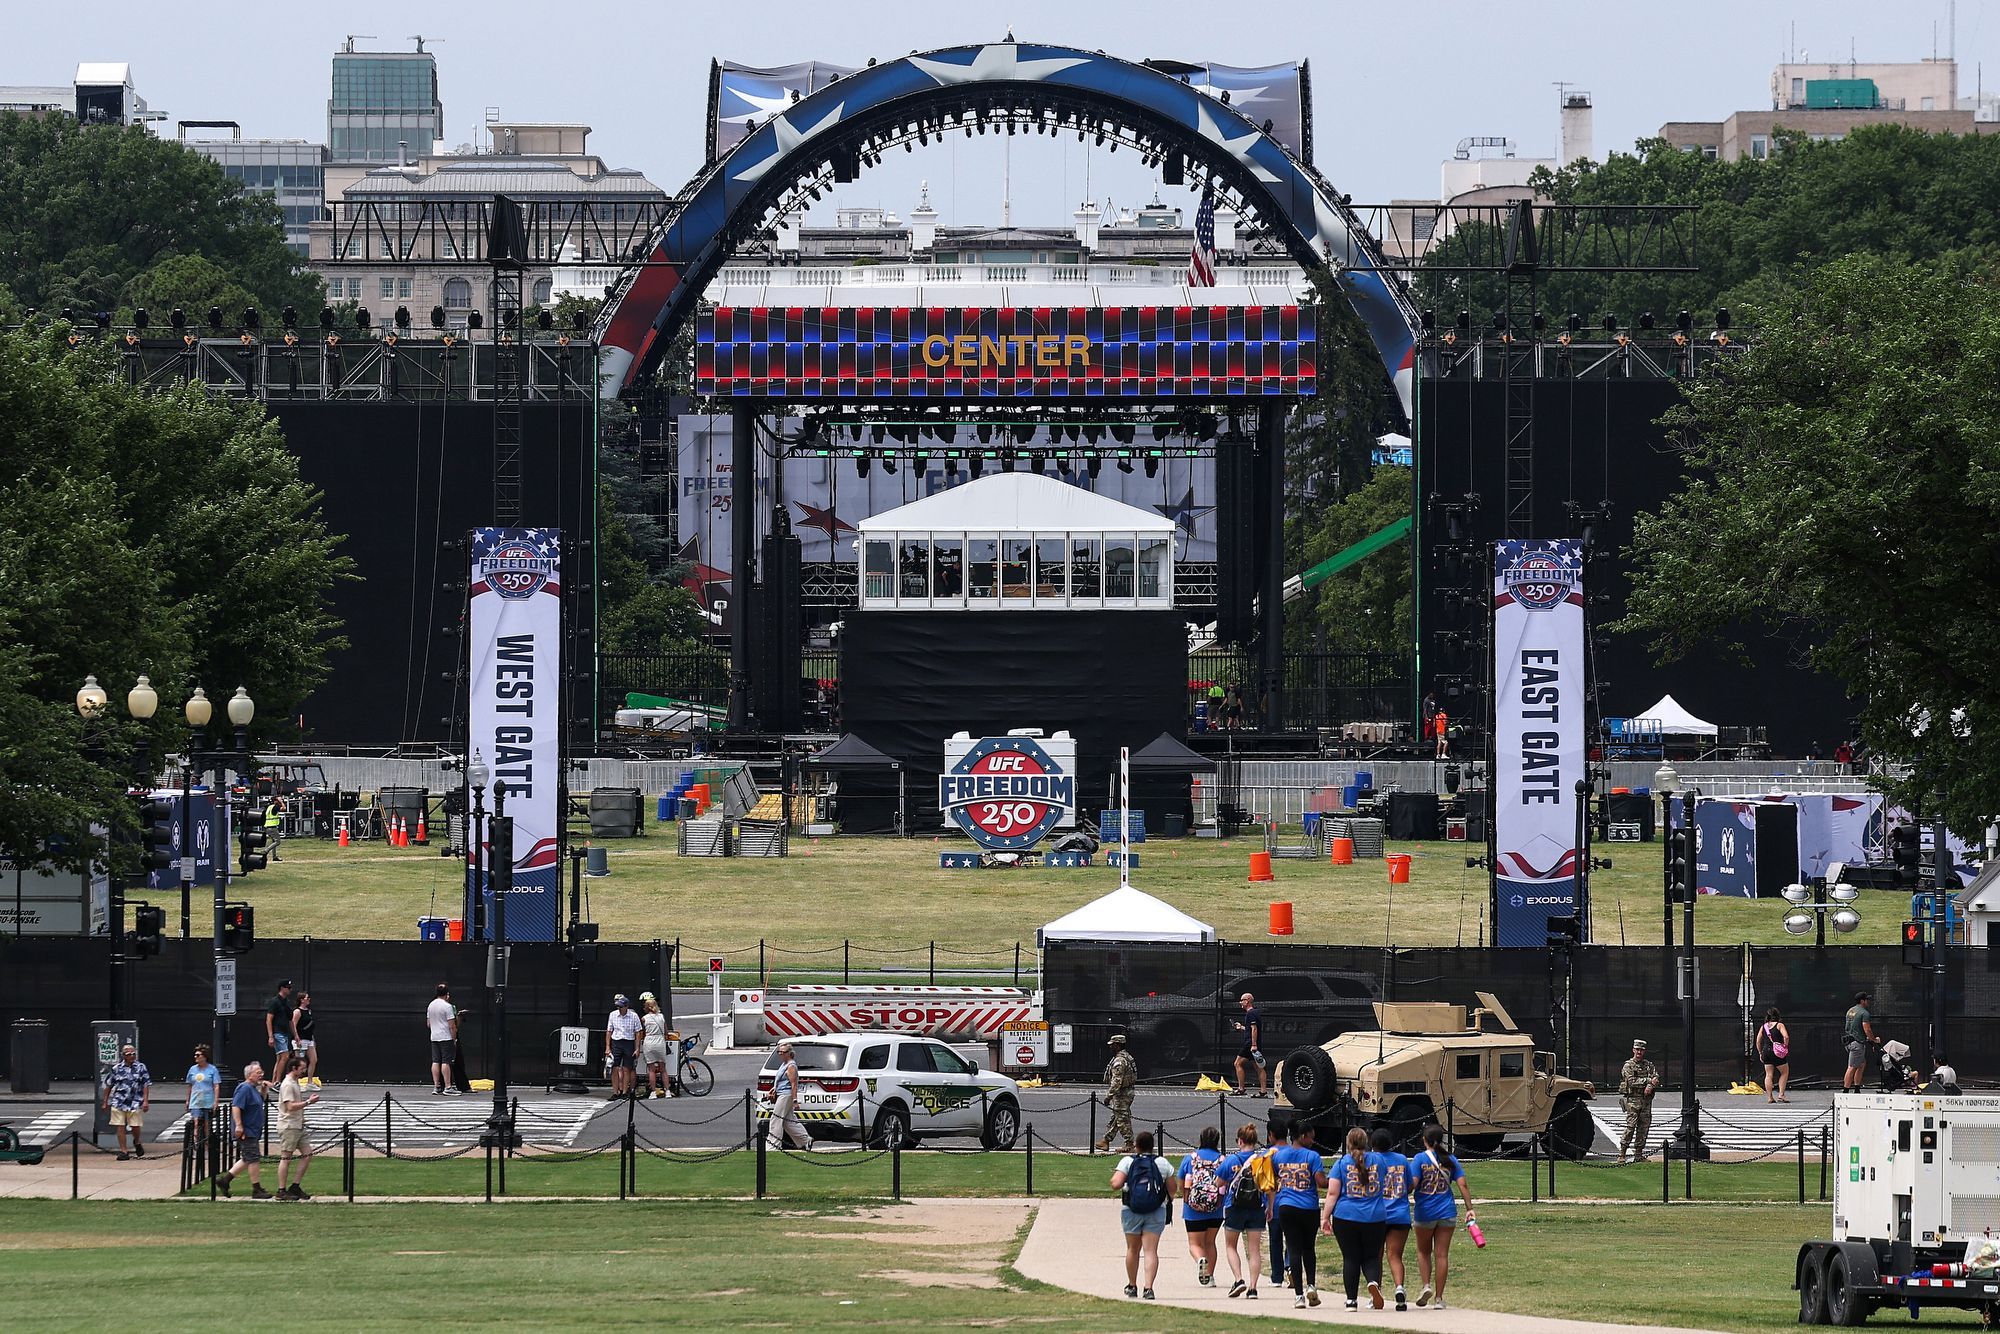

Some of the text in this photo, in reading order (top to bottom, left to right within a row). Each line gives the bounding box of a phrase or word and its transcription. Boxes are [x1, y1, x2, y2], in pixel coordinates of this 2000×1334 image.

[922, 335, 1091, 367] CENTER
[716, 465, 735, 473] UF
[712, 495, 732, 512] 25
[506, 550, 526, 558] UFC
[480, 559, 552, 574] FREEDOM
[501, 574, 531, 589] 250
[1503, 570, 1575, 586] FREEDOM
[1526, 585, 1555, 600] 250
[495, 634, 534, 799] WEST GATE
[1521, 650, 1560, 805] EAST GATE
[988, 756, 1026, 771] UFC
[940, 776, 1073, 810] FREEDOM
[981, 803, 1036, 833] 250
[1526, 896, 1573, 904] EXODUS
[850, 1009, 951, 1024] STOP
[100, 1043, 117, 1051] WAR
[562, 1051, 585, 1060] CHECK
[804, 1095, 837, 1104] POLICE
[912, 1097, 970, 1109] POLICE
